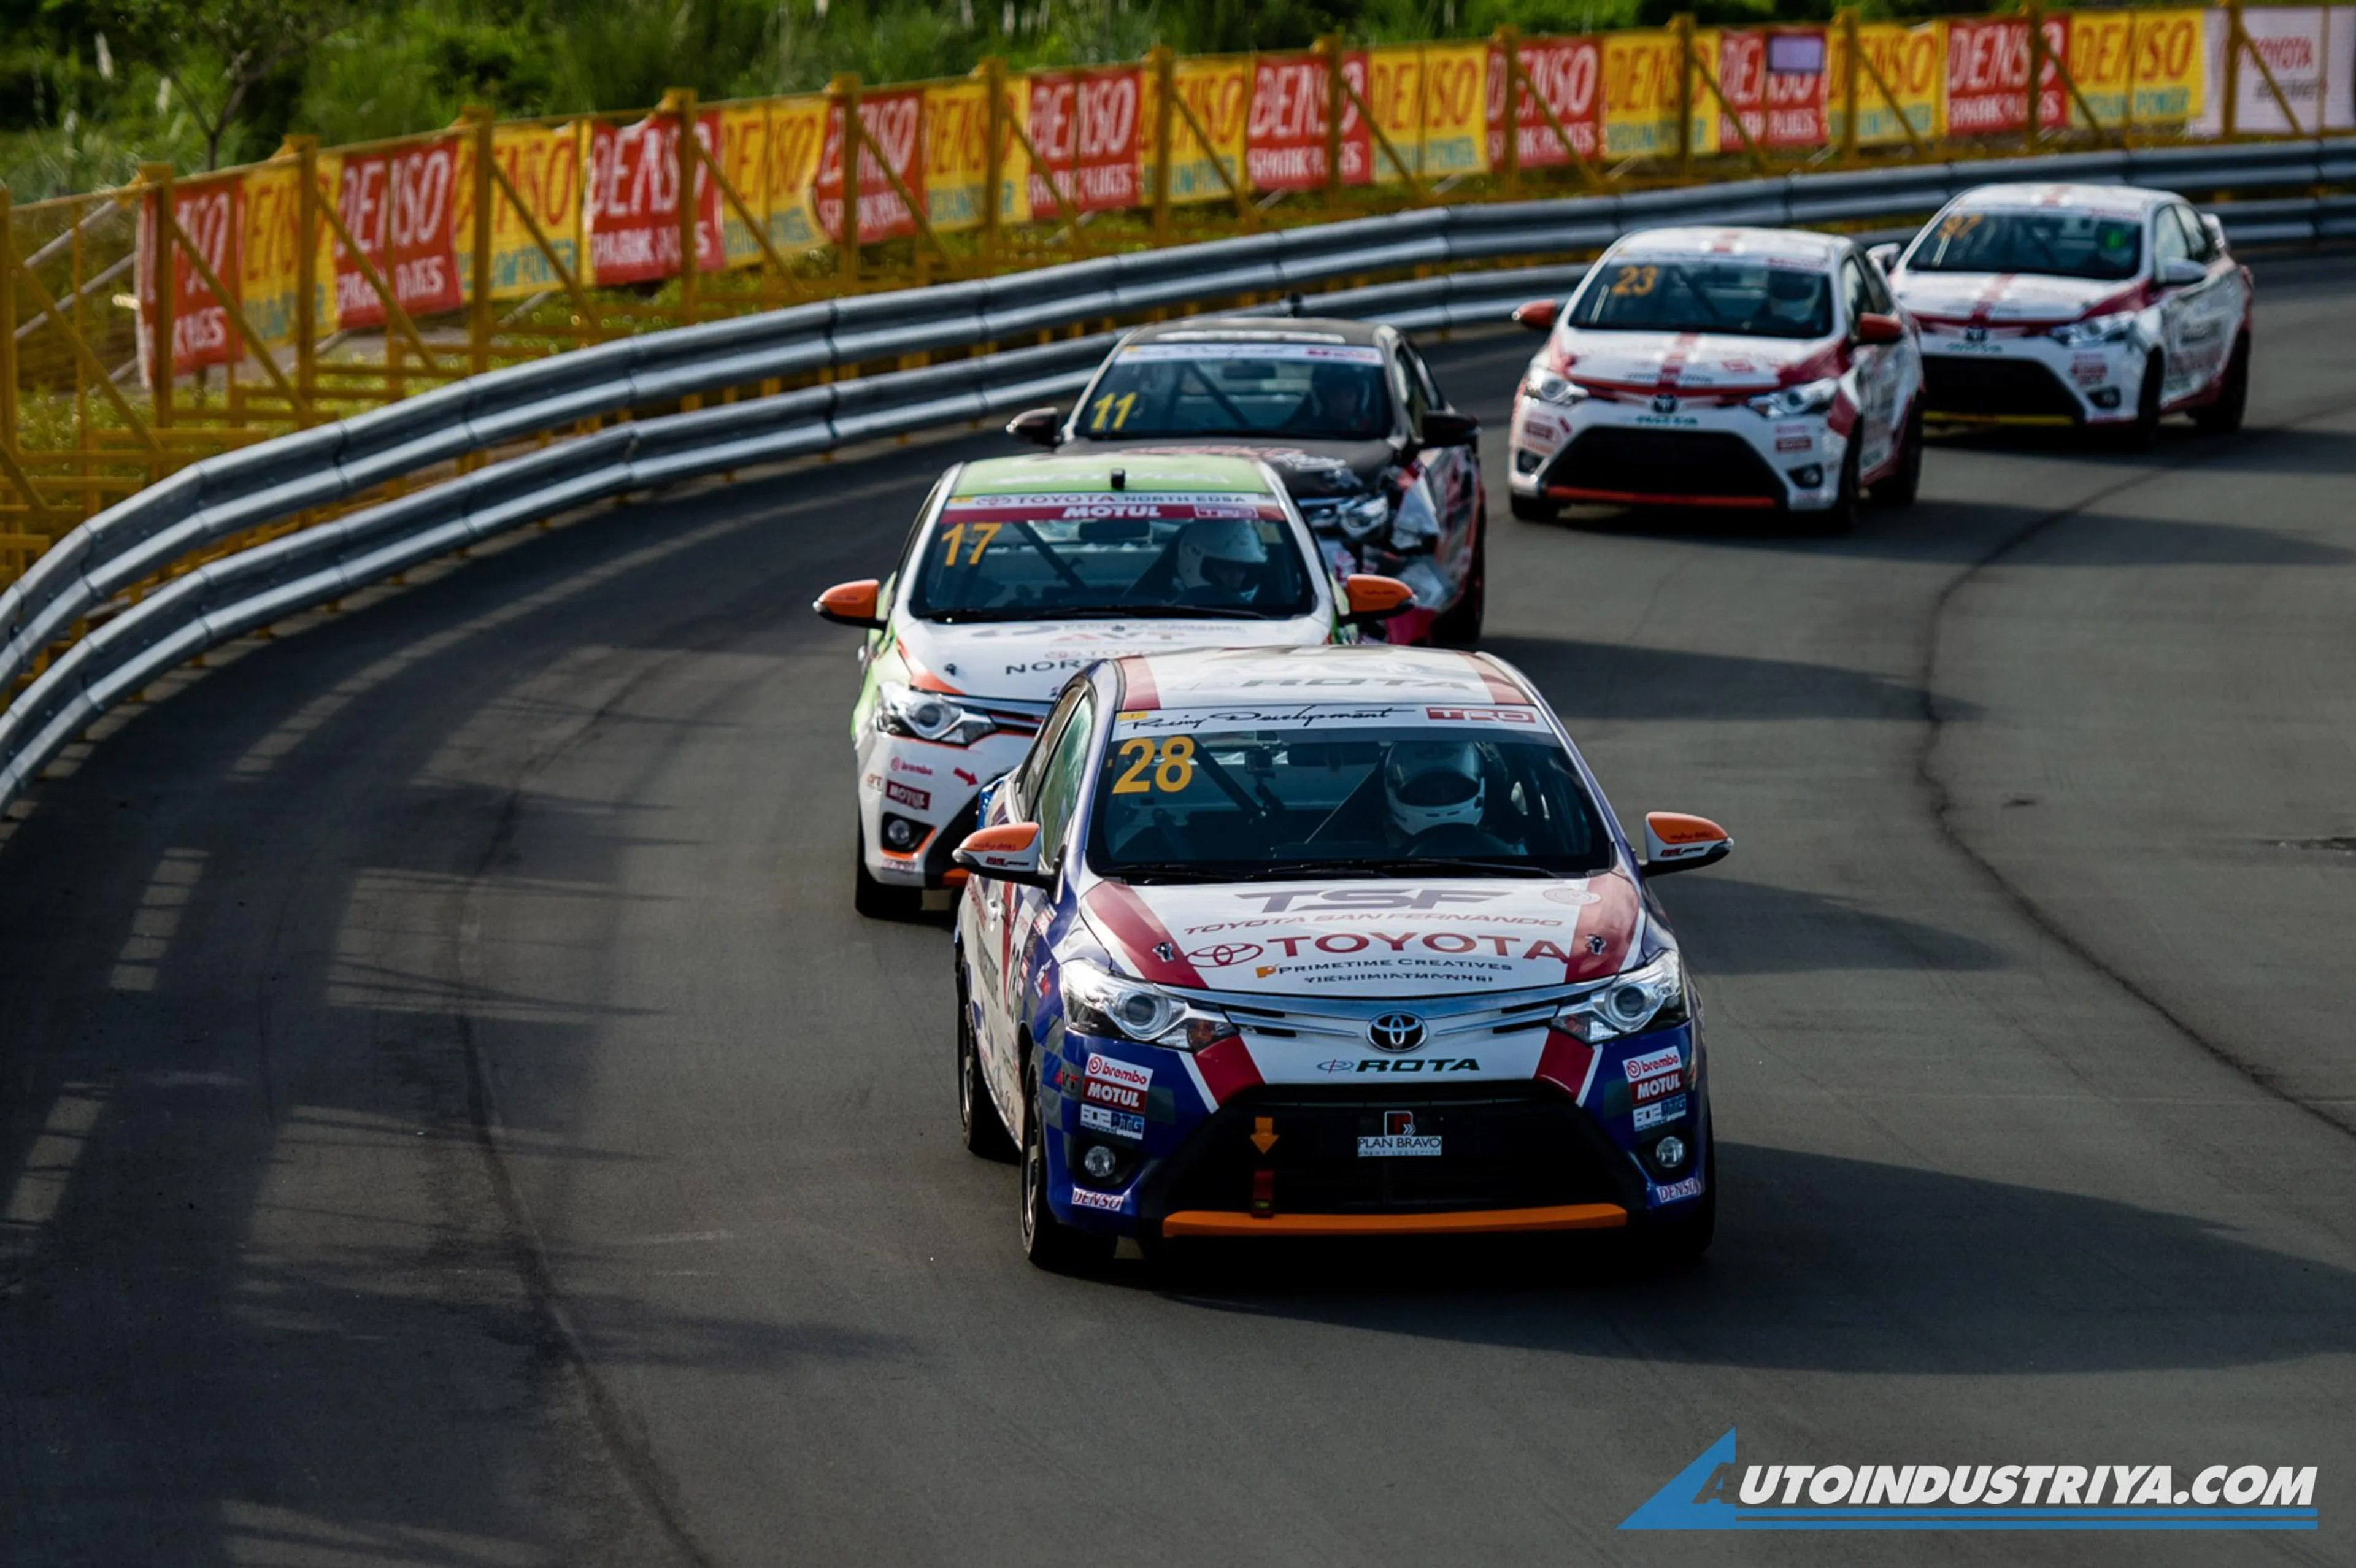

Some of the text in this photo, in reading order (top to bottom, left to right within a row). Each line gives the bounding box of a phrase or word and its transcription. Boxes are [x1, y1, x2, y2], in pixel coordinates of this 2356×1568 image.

[2072, 18, 2195, 85] DENSO
[1374, 59, 1477, 130] DENSO
[1610, 264, 1659, 296] 23
[1091, 391, 1137, 431] 11
[1019, 494, 1116, 505] TOYOTA
[1061, 505, 1161, 518] MOTUL
[940, 523, 1003, 567] 17
[1241, 678, 1471, 691] ROTA
[1428, 709, 1533, 723] TRD
[901, 761, 934, 776] brembo
[1112, 736, 1195, 795] 28
[890, 784, 925, 809] MOTUL
[1233, 889, 1514, 913] TSF
[1184, 912, 1563, 936] TOYOTA SAN FERNANDO
[1266, 932, 1569, 964] TOYOTA
[1279, 958, 1513, 974] PRIMETIME CREATIVES
[1102, 1062, 1147, 1086] brembo
[1356, 1058, 1480, 1073] ROTA
[1640, 1054, 1679, 1074] brembo
[1087, 1082, 1140, 1107] MOTUL
[1636, 1073, 1681, 1099] MOTUL
[1358, 1137, 1441, 1149] PLAN BRAVO
